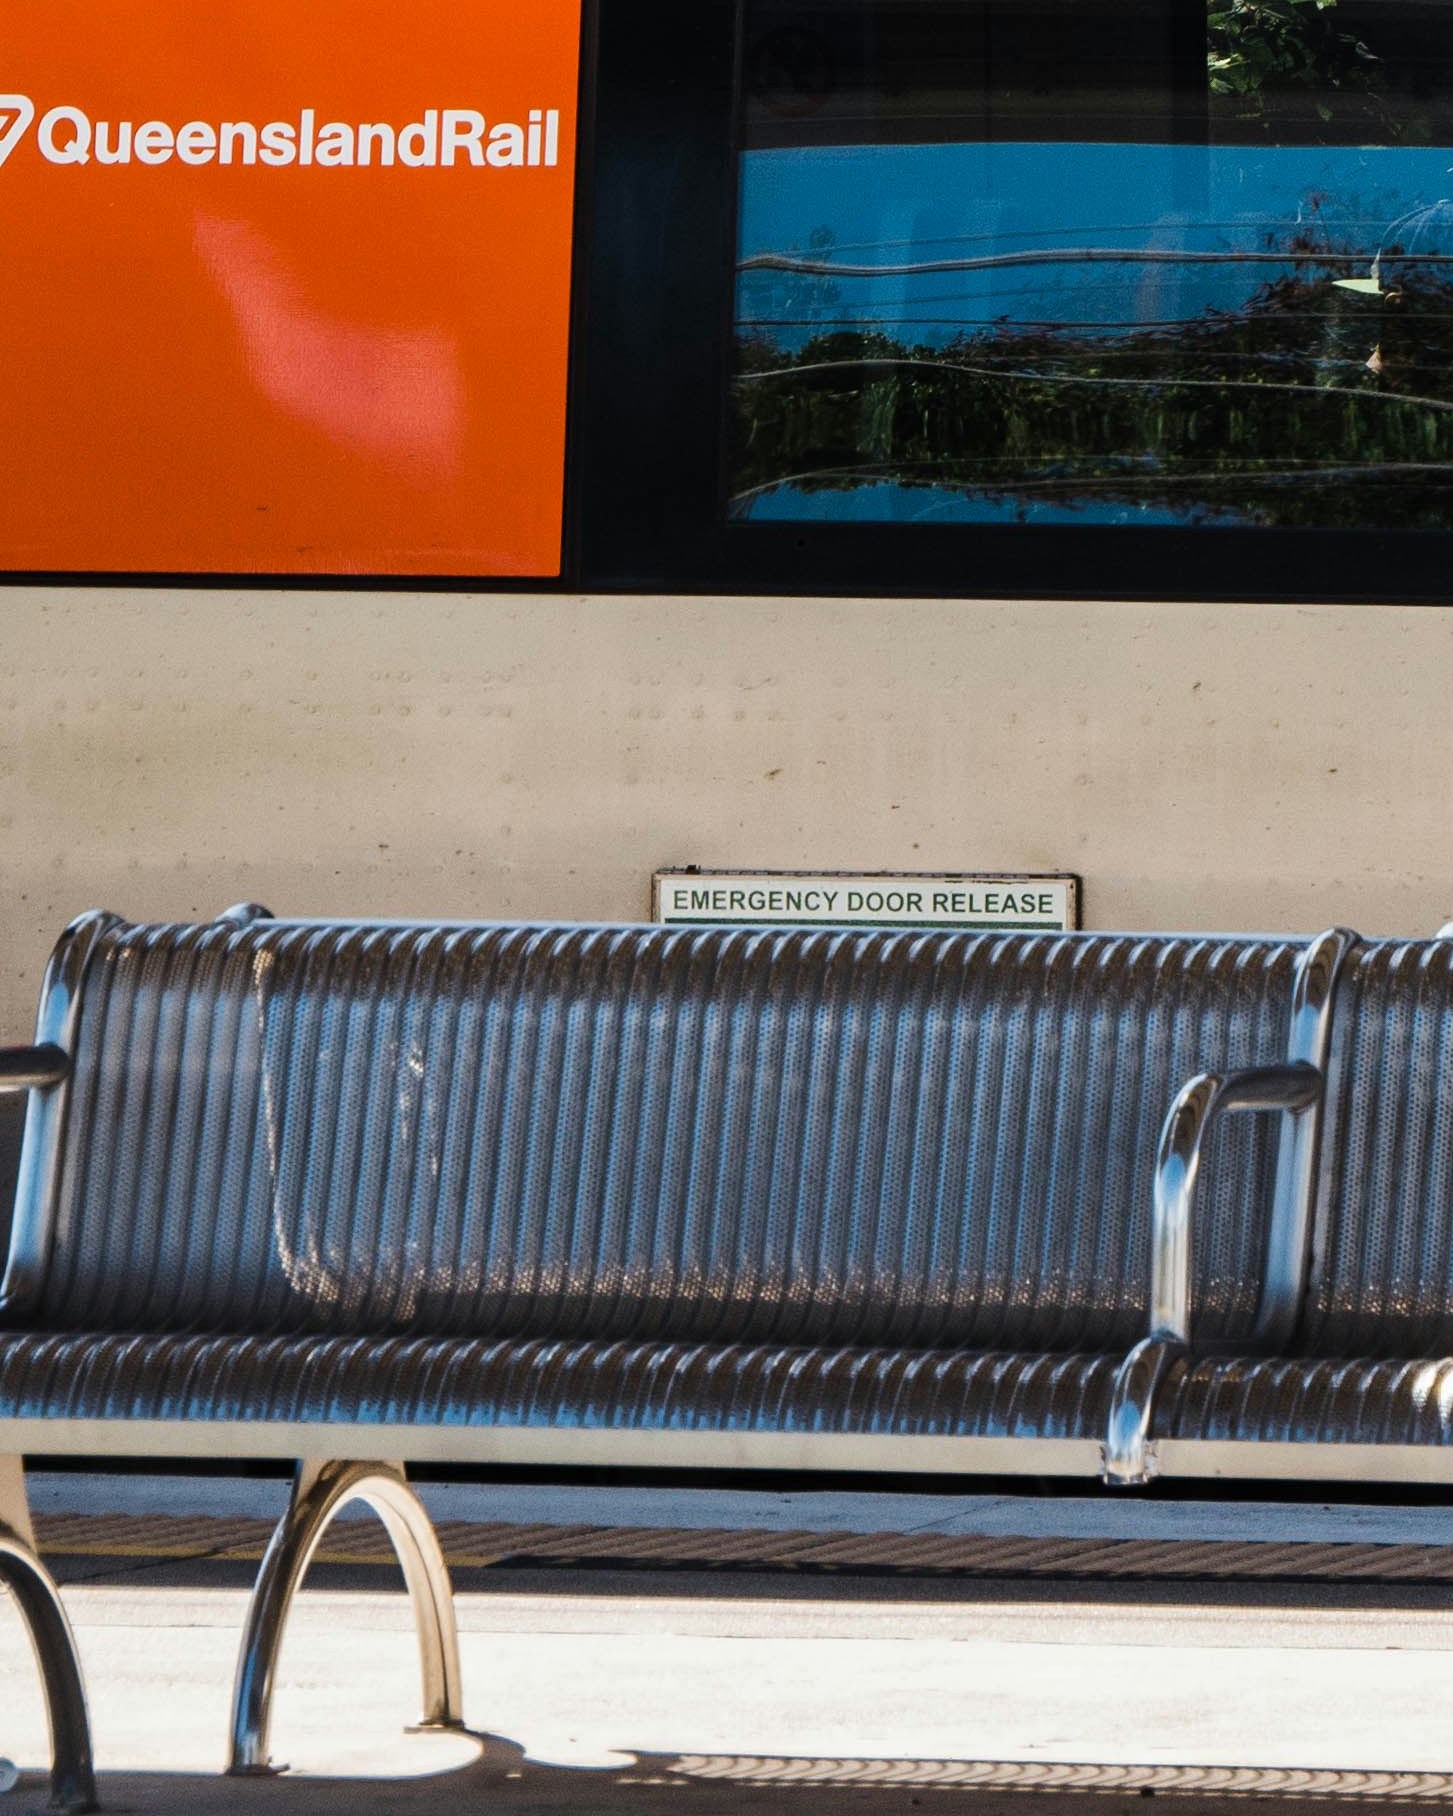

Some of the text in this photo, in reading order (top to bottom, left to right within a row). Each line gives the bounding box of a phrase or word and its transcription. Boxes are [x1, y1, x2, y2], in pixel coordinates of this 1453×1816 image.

[37, 105, 559, 166] QueenslandRail
[673, 889, 1054, 914] EMERGENCY DOOR RELEASE
